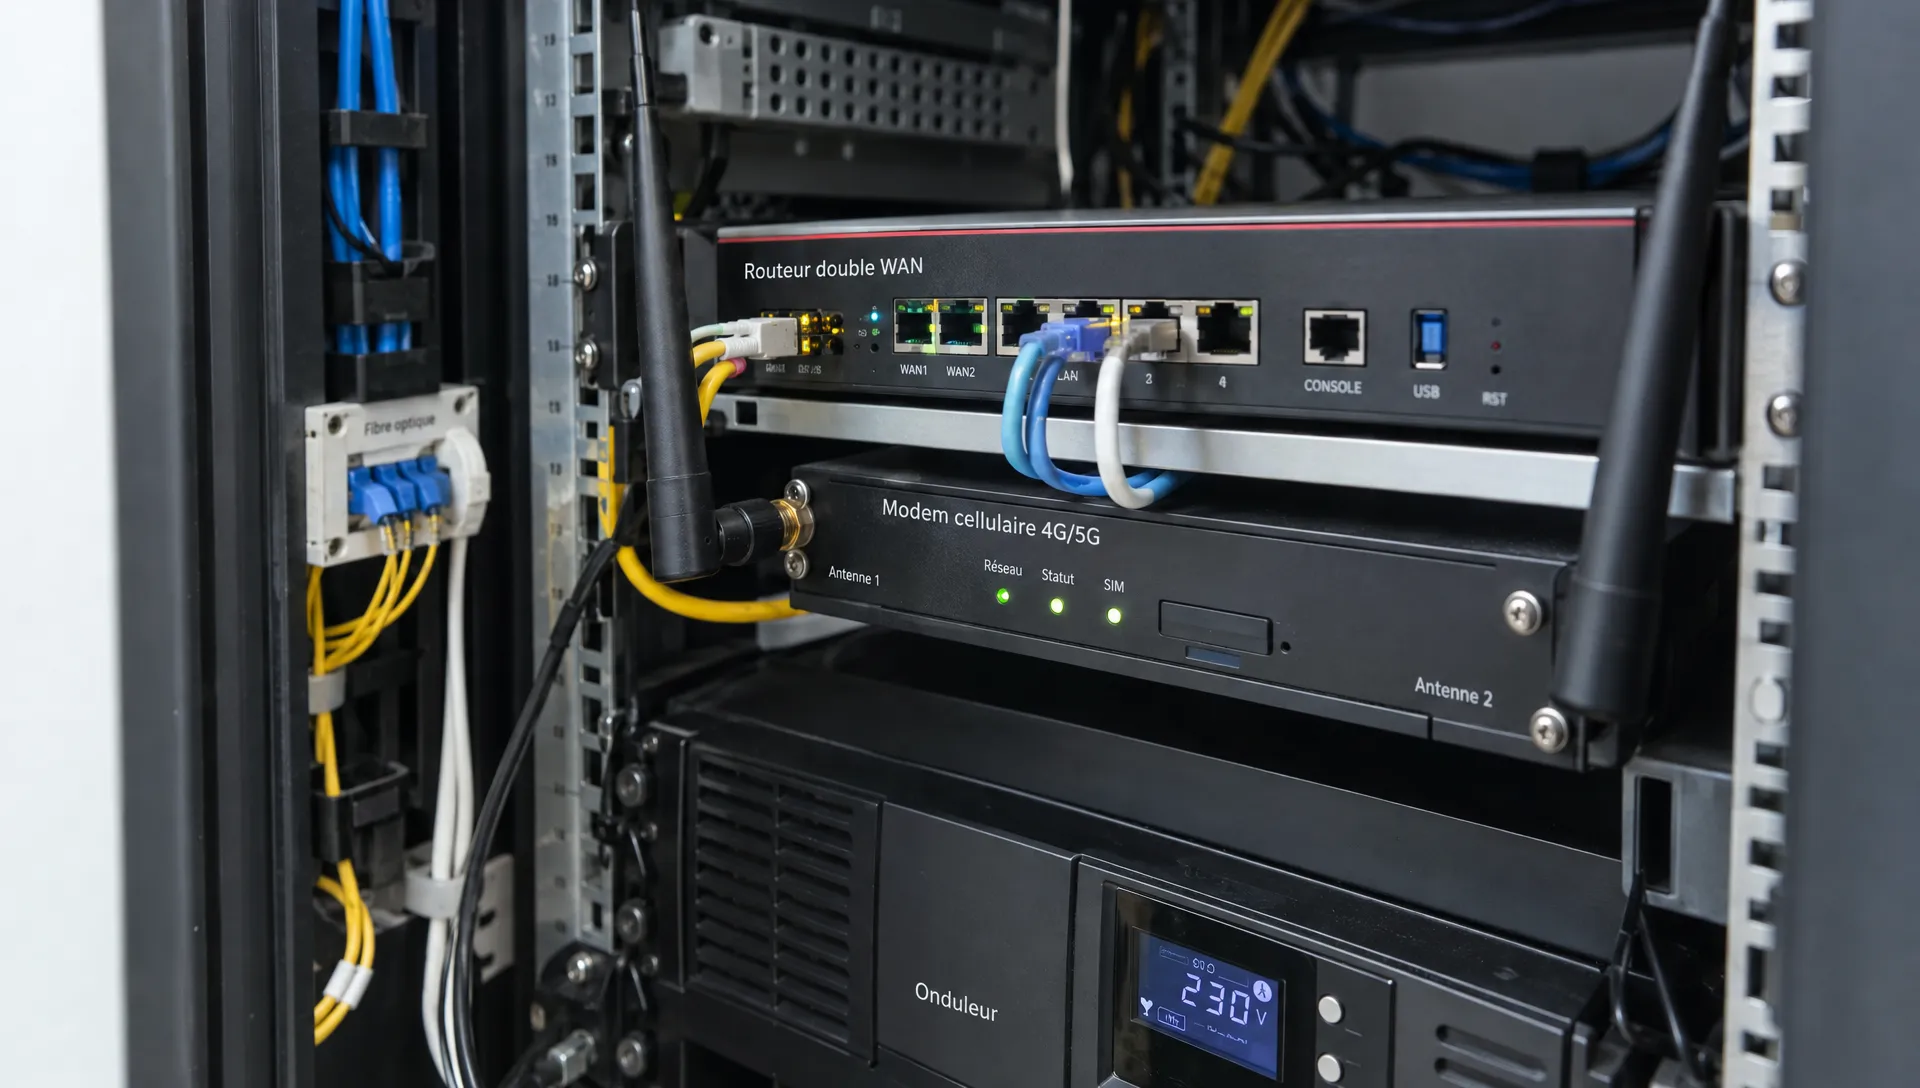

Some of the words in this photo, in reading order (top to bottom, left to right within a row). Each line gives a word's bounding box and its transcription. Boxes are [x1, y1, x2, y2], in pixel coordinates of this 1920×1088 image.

[744, 262, 812, 280] Routeur
[815, 259, 875, 277] double
[880, 256, 924, 276] WAN
[899, 364, 928, 377] WAN1
[946, 365, 976, 378] WAN2
[1218, 375, 1227, 388] 4
[1303, 378, 1363, 395] CONSOLE
[1412, 383, 1441, 400] USB
[364, 421, 392, 436] Fibre
[394, 414, 436, 435] optique
[882, 498, 949, 525] Modem
[954, 510, 1037, 537] cellulaire
[1041, 521, 1101, 546] 4G/5G
[828, 565, 872, 585] Antenne
[874, 574, 880, 587] 1
[983, 558, 1023, 577] Réseau
[1041, 568, 1075, 586] Statut
[1103, 578, 1125, 593] SIM
[1414, 676, 1479, 705] Antenne
[1482, 690, 1493, 708] 2
[915, 982, 999, 1022] Onduleur
[1181, 973, 1251, 1026] 230
[1256, 1008, 1267, 1026] V
